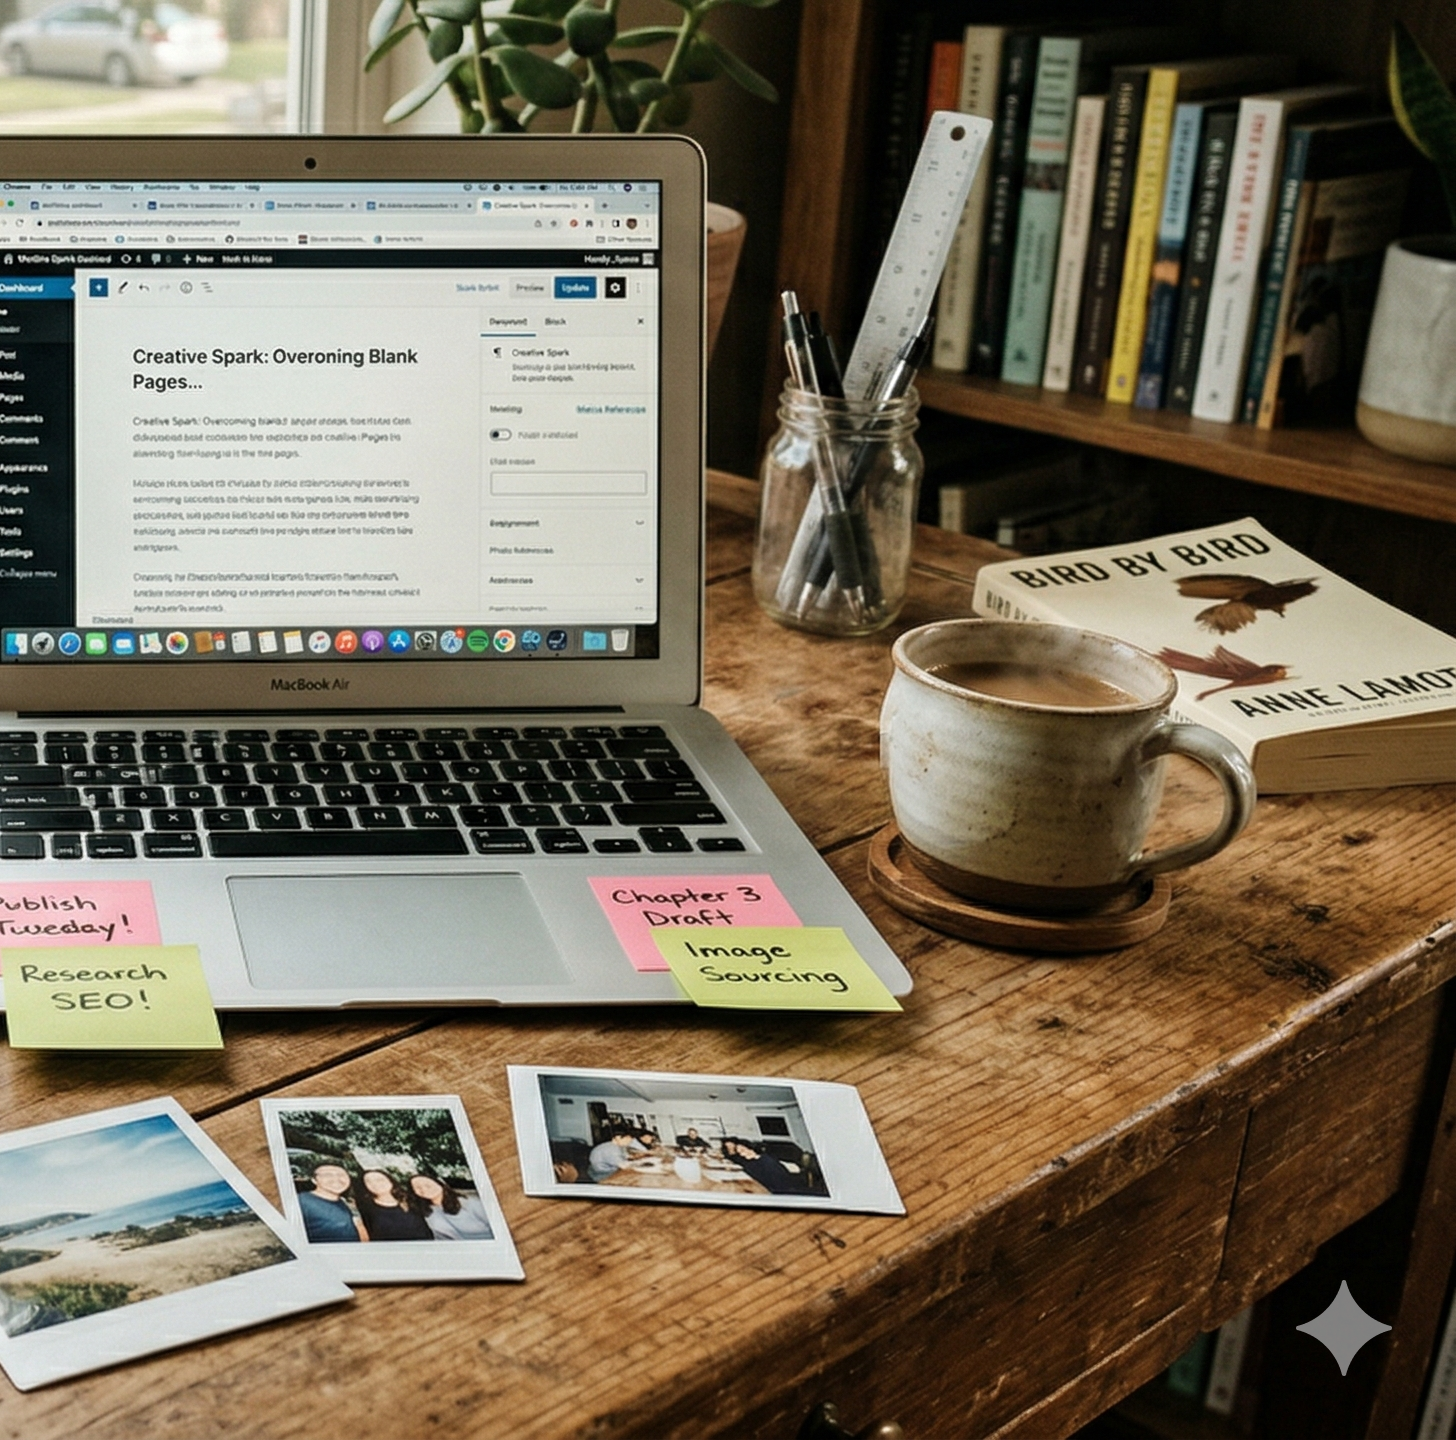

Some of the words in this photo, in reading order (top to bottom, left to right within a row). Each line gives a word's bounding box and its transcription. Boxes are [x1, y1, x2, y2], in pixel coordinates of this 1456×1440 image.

[561, 283, 590, 294] Update
[133, 348, 207, 365] Creative
[212, 348, 269, 368] Spark:
[273, 348, 364, 368] Overoning
[369, 348, 418, 364] Blank
[133, 373, 203, 392] Pages...
[1010, 562, 1110, 588] BIRD
[1111, 551, 1168, 577] BY
[1170, 533, 1271, 567] BIRD
[271, 679, 329, 692] MacBook
[332, 679, 350, 691] Air
[1230, 688, 1343, 718] ANNE
[612, 888, 729, 909] Chapter
[735, 886, 762, 902] 3
[643, 908, 734, 926] Draft
[685, 941, 792, 965] Image
[21, 964, 168, 983] Research
[700, 965, 849, 992] Sourcing
[51, 989, 151, 1011] SEO!
